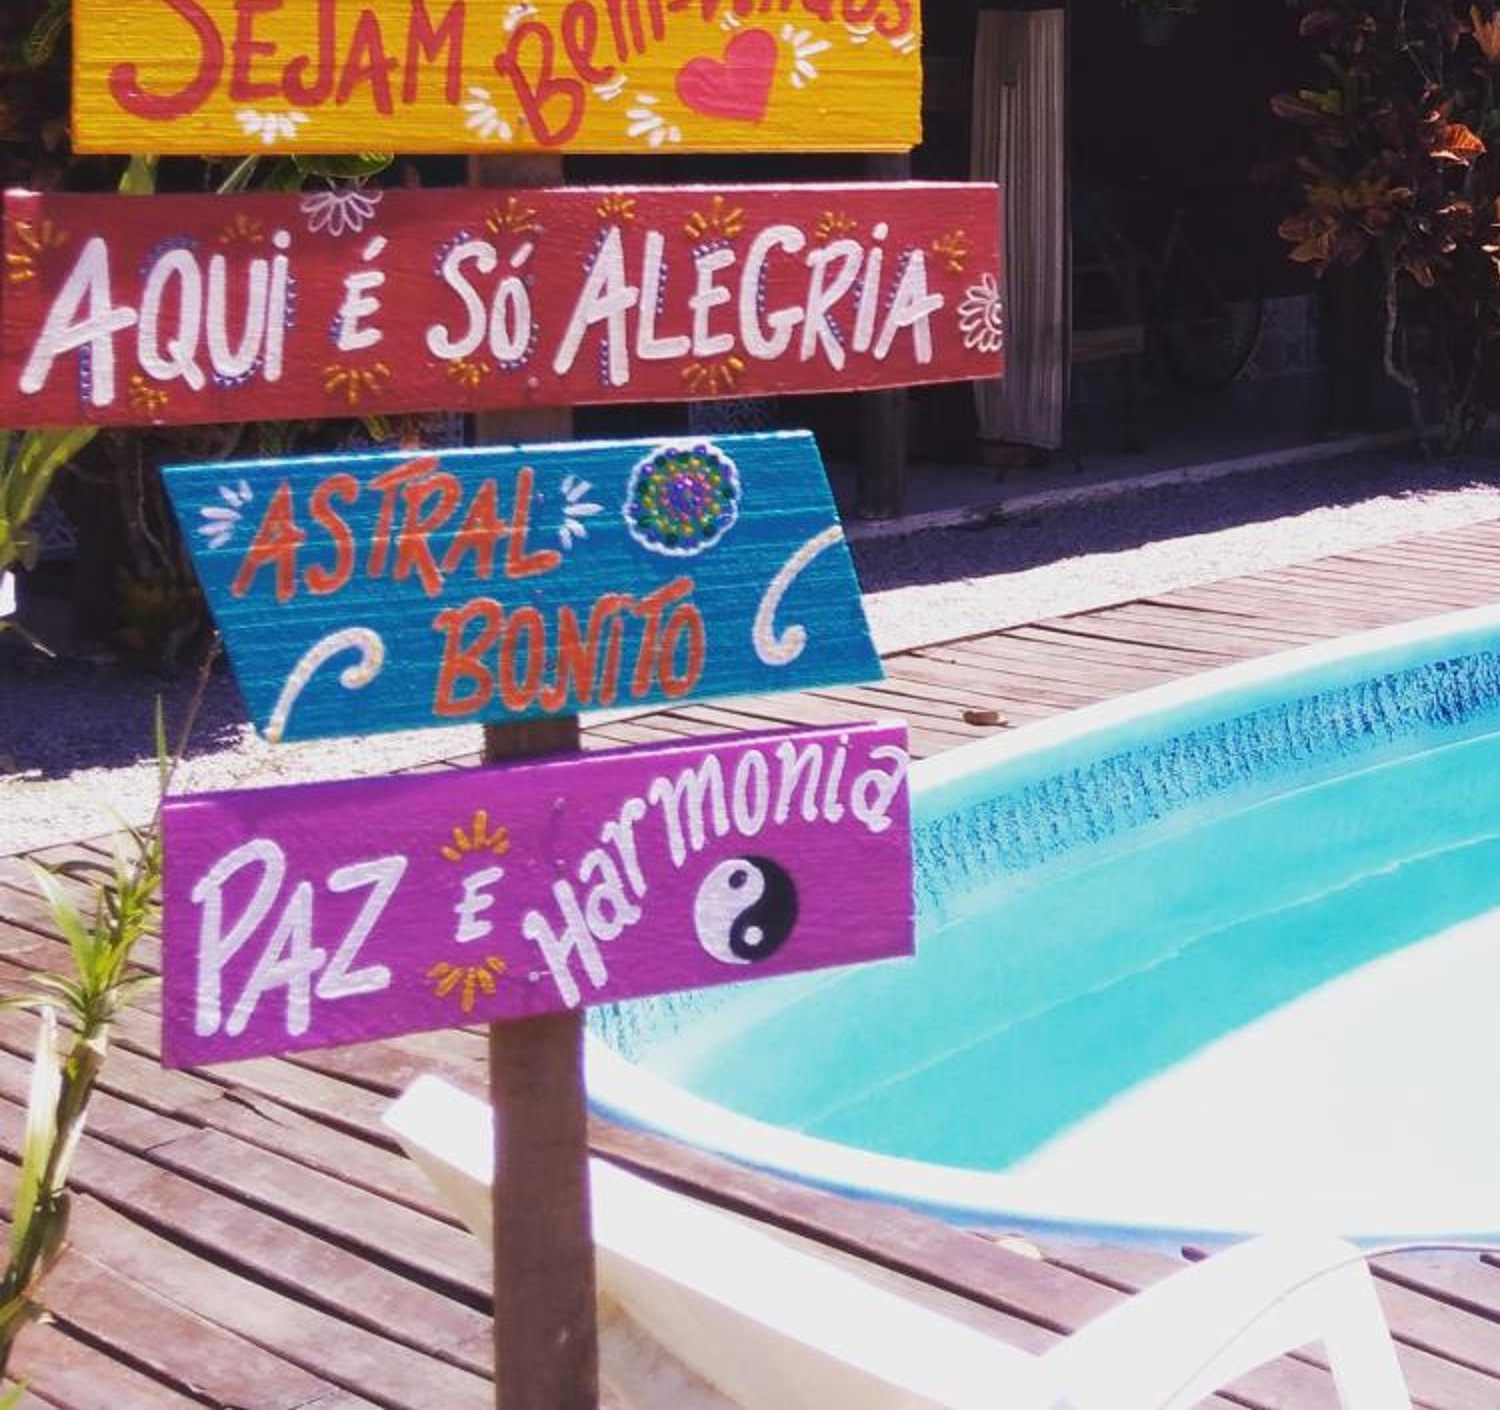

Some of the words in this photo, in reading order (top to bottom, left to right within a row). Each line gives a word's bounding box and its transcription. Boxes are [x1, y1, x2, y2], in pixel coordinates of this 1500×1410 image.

[18, 231, 292, 406] AQUI
[337, 237, 386, 352] É
[553, 221, 944, 386] ALEGRIA
[231, 456, 561, 602] ASTRAL
[431, 577, 705, 718] BONITO
[191, 838, 408, 1037] PAZ
[453, 867, 504, 943] E
[522, 733, 908, 1010] Harmonia
